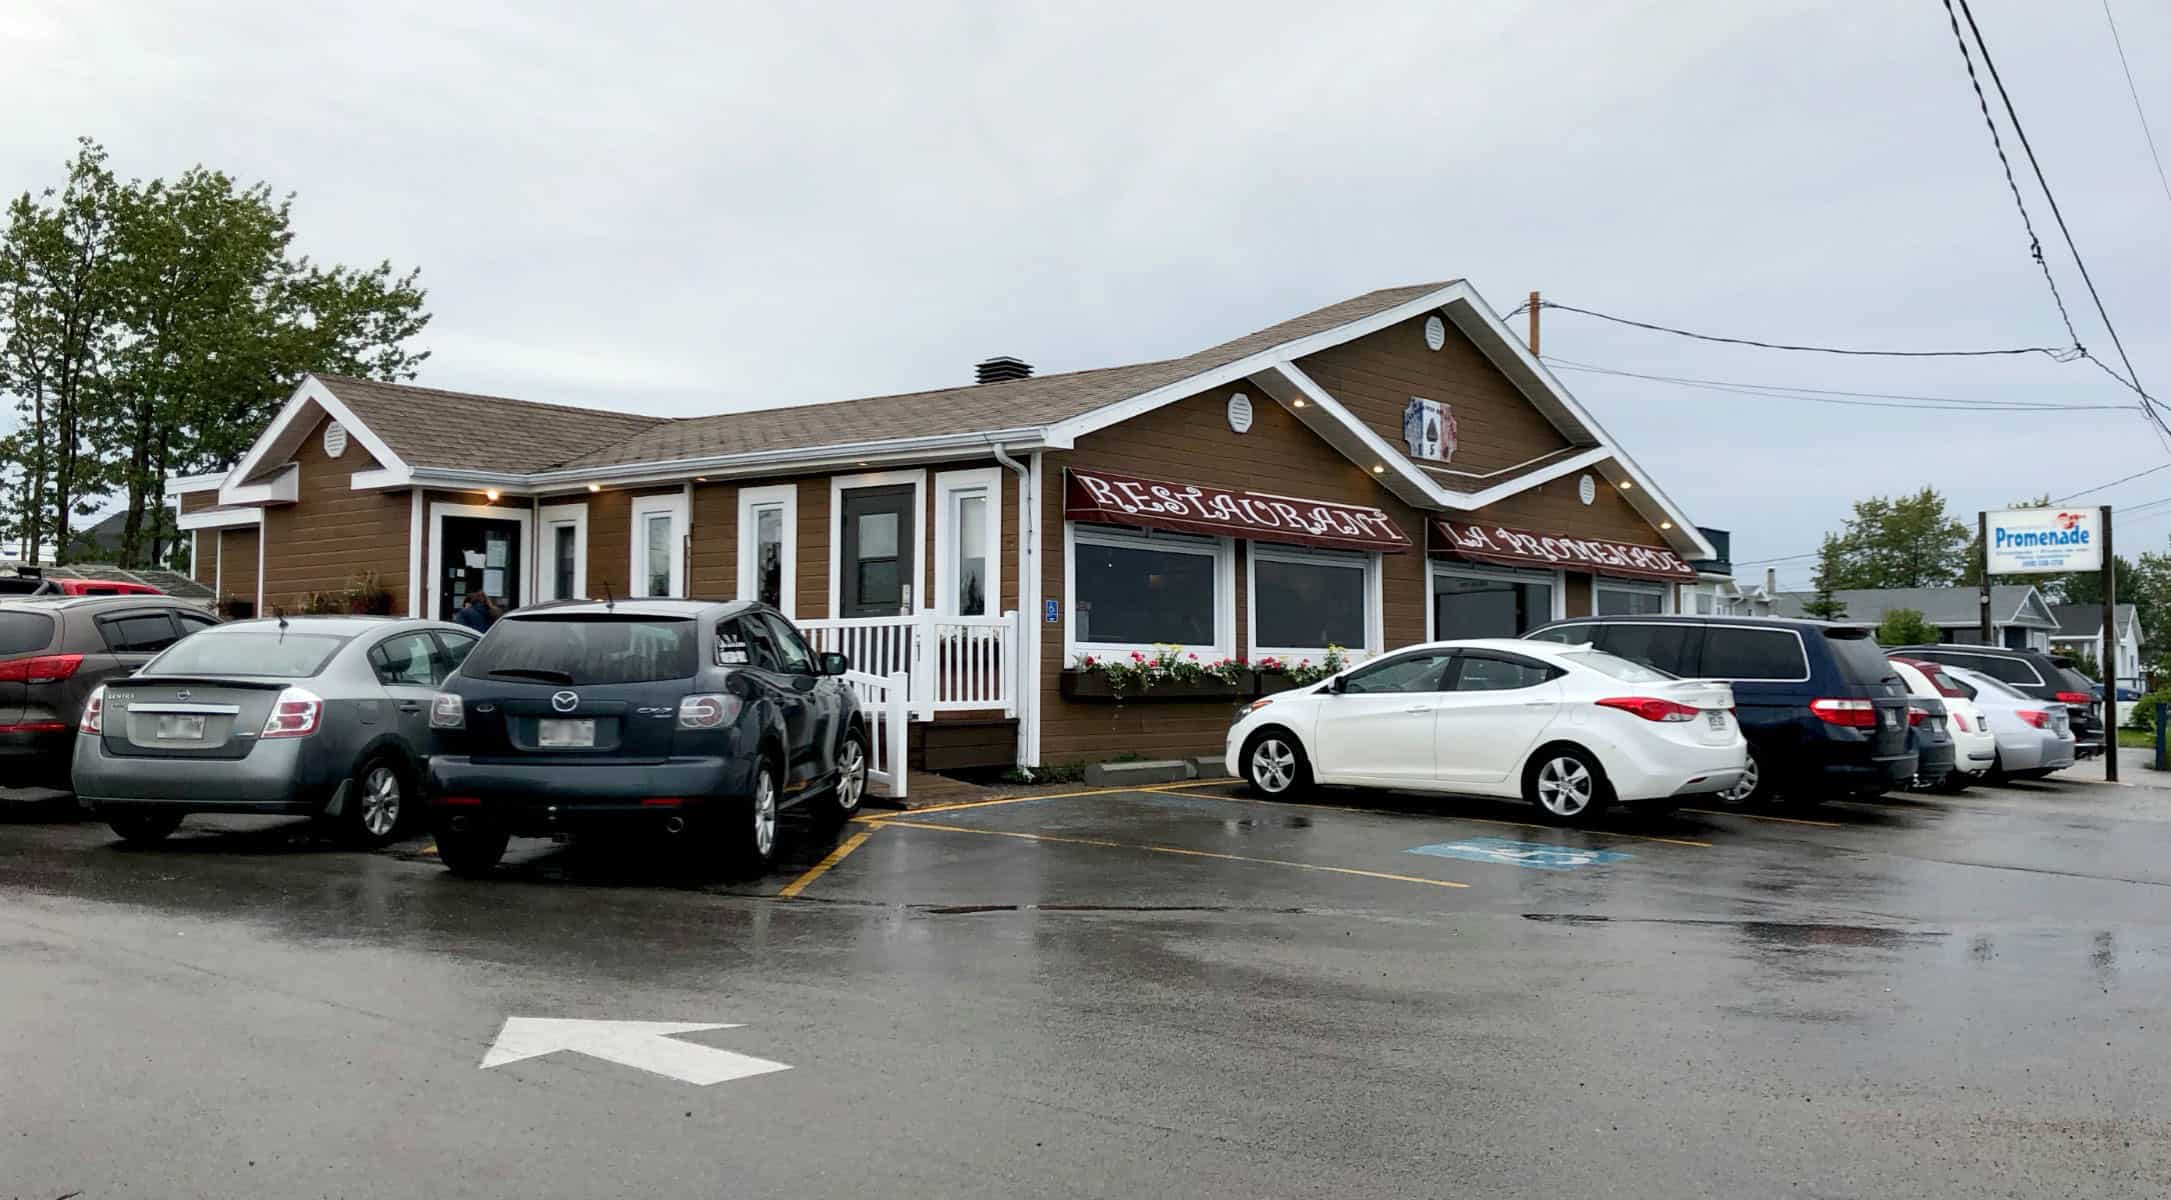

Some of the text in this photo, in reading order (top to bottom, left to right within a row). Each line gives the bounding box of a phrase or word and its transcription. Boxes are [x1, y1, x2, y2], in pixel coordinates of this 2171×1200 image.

[1077, 474, 1403, 539] RESTAURANT
[1439, 521, 1692, 573] LA PROMENADE
[1995, 525, 2089, 548] Promenade
